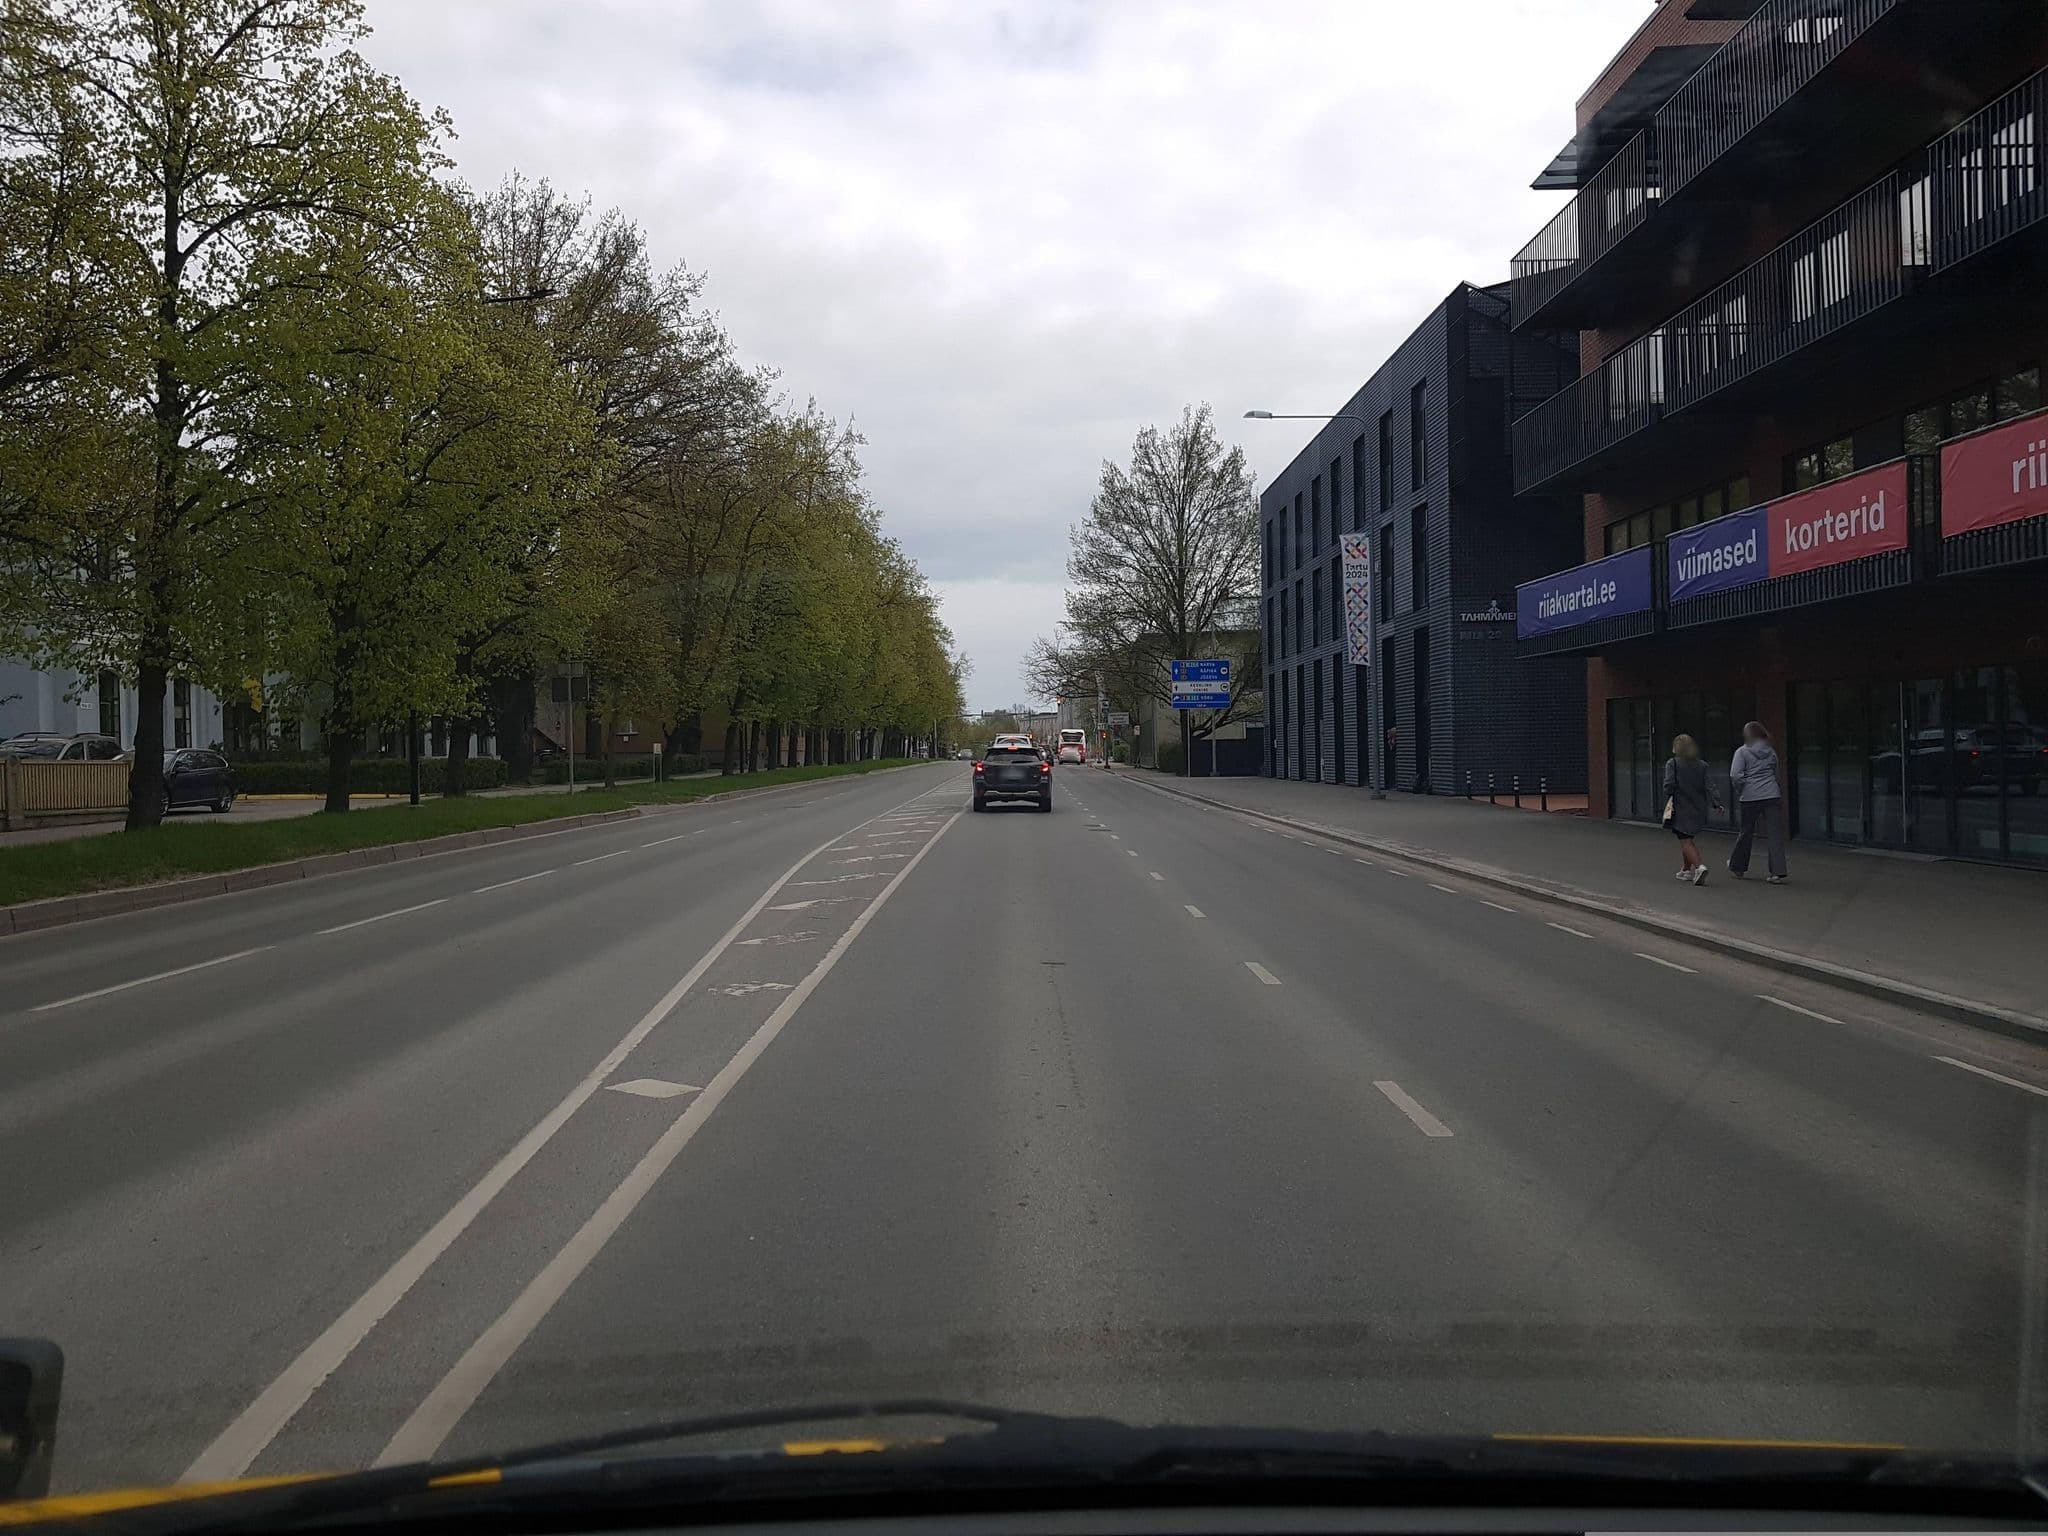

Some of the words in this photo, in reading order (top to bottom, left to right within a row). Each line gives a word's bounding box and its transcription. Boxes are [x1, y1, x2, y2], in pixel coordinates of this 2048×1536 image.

[1677, 528, 1757, 582] viimased
[1785, 490, 1885, 554] korterid
[1345, 563, 1368, 571] Tartu
[1345, 571, 1368, 579] 2024
[1538, 578, 1617, 619] riiakvartal.ee
